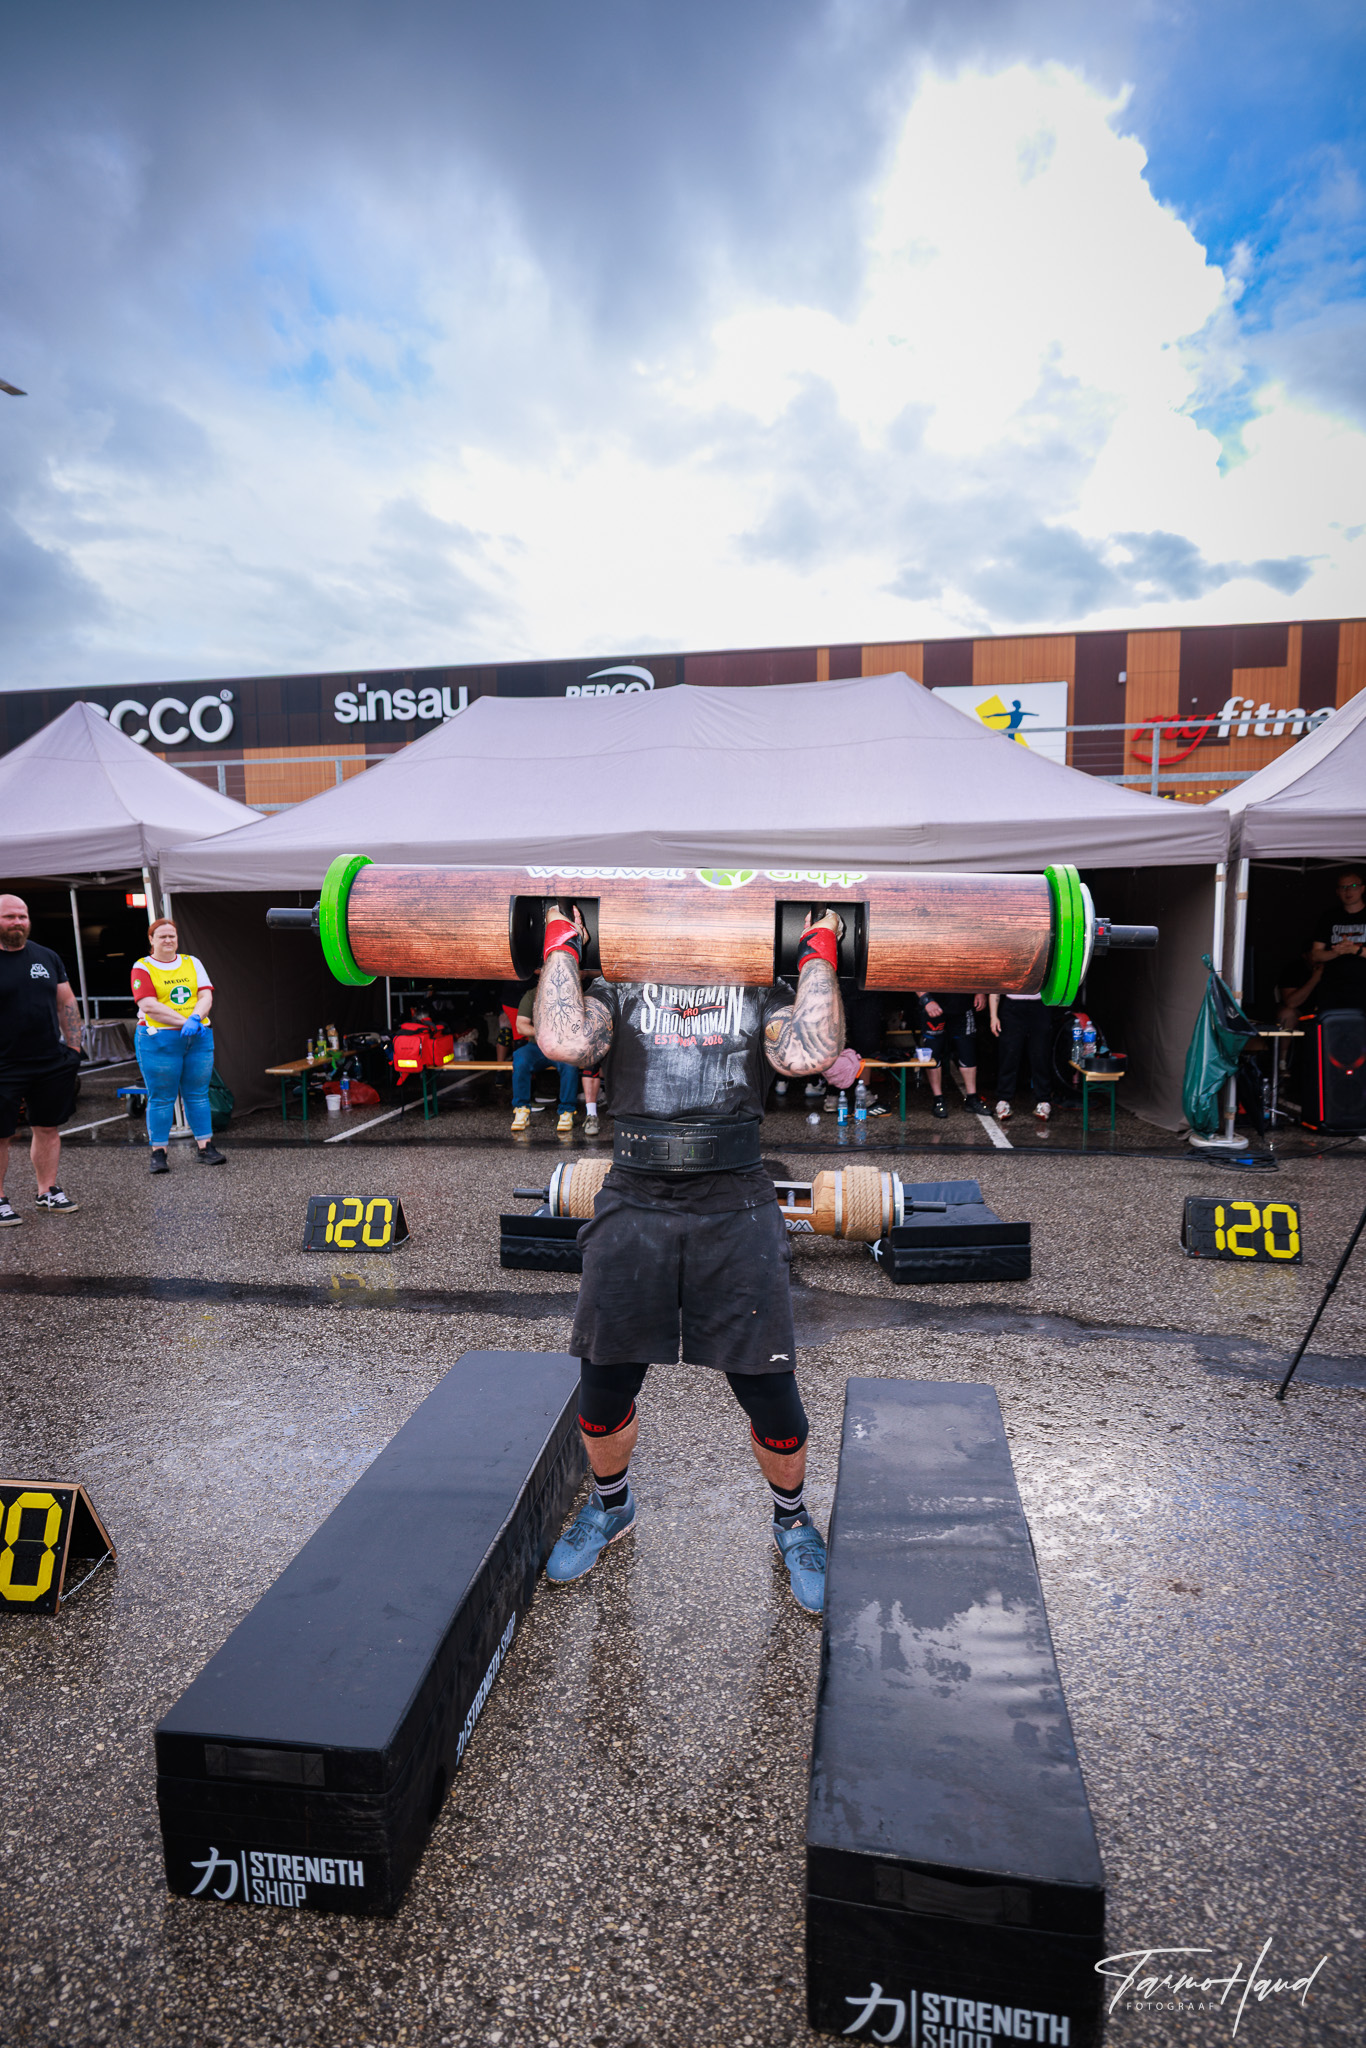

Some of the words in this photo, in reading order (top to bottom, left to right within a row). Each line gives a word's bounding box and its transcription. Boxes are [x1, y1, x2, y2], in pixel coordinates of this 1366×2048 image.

[334, 683, 468, 724] sinsay
[164, 977, 190, 986] MEDIC
[654, 1034, 697, 1047] ESTONIA
[702, 1034, 724, 1046] 2026
[325, 1198, 393, 1248] 120
[1214, 1201, 1300, 1259] 120
[466, 1645, 500, 1740] STRENGTH
[500, 1611, 516, 1661] SHOP
[250, 1851, 364, 1887] STRENGTH
[252, 1878, 306, 1908] SHOP
[922, 1992, 1070, 2047] STRENGTH
